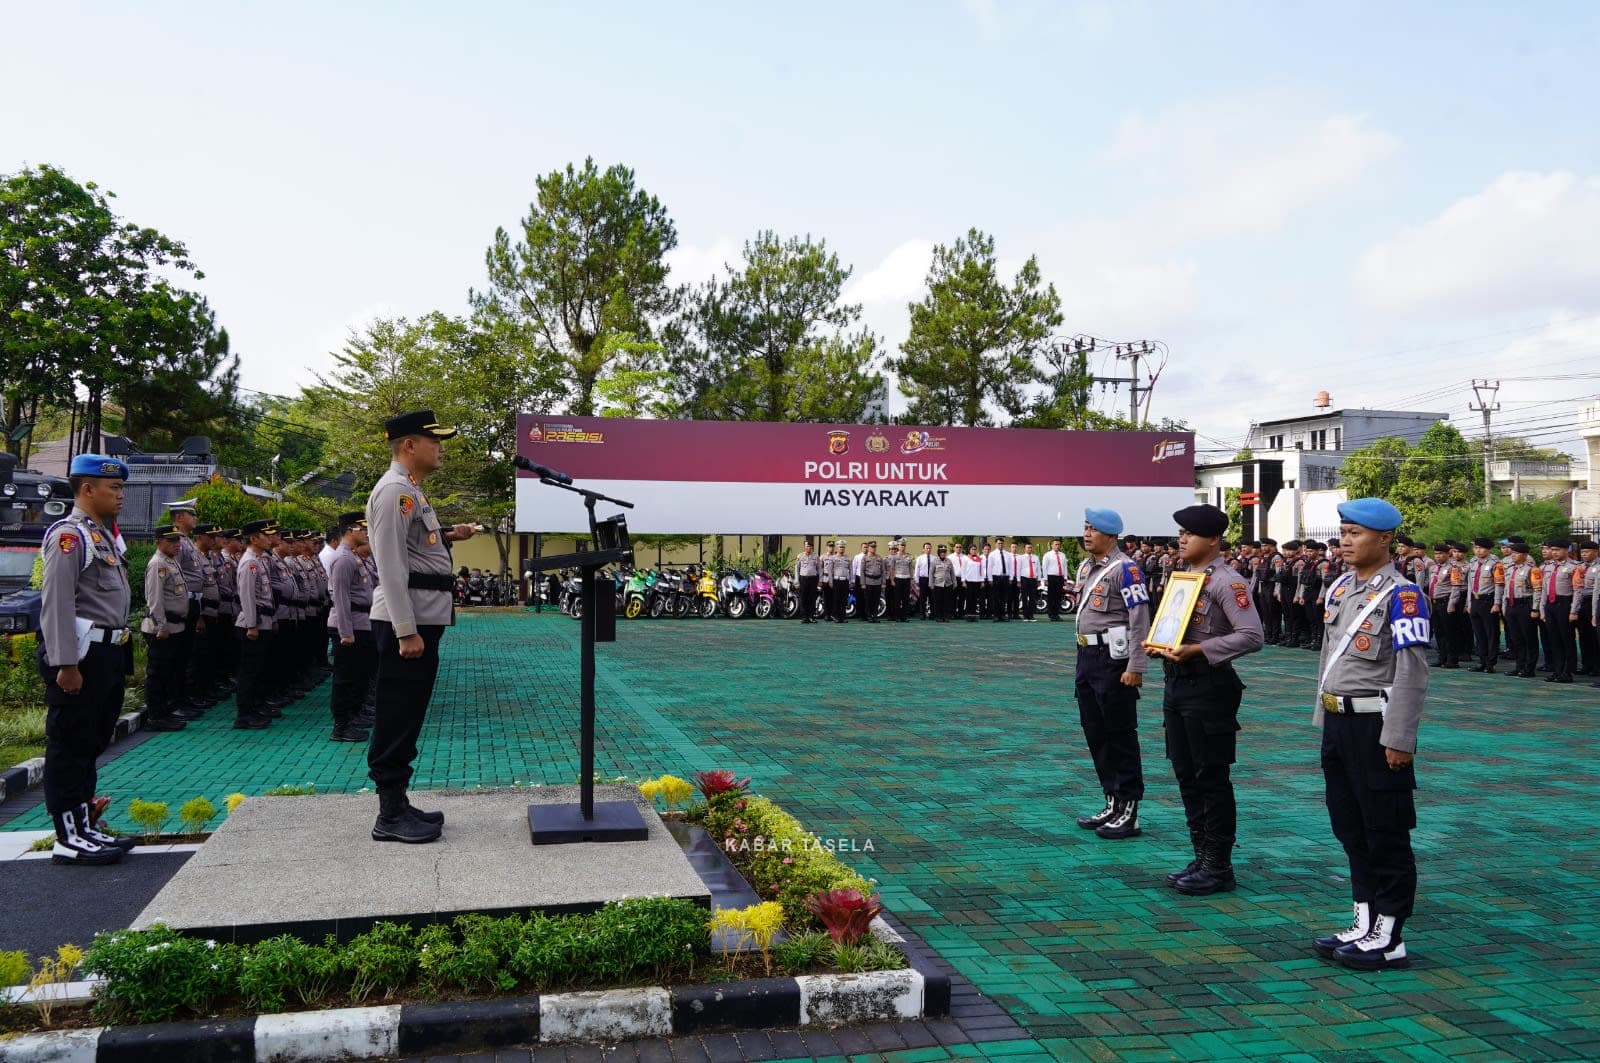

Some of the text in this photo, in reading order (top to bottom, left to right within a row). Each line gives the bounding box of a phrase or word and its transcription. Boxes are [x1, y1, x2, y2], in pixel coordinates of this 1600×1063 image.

[804, 461, 948, 481] POLRI UNTUK
[804, 489, 949, 507] MASYARAKAT
